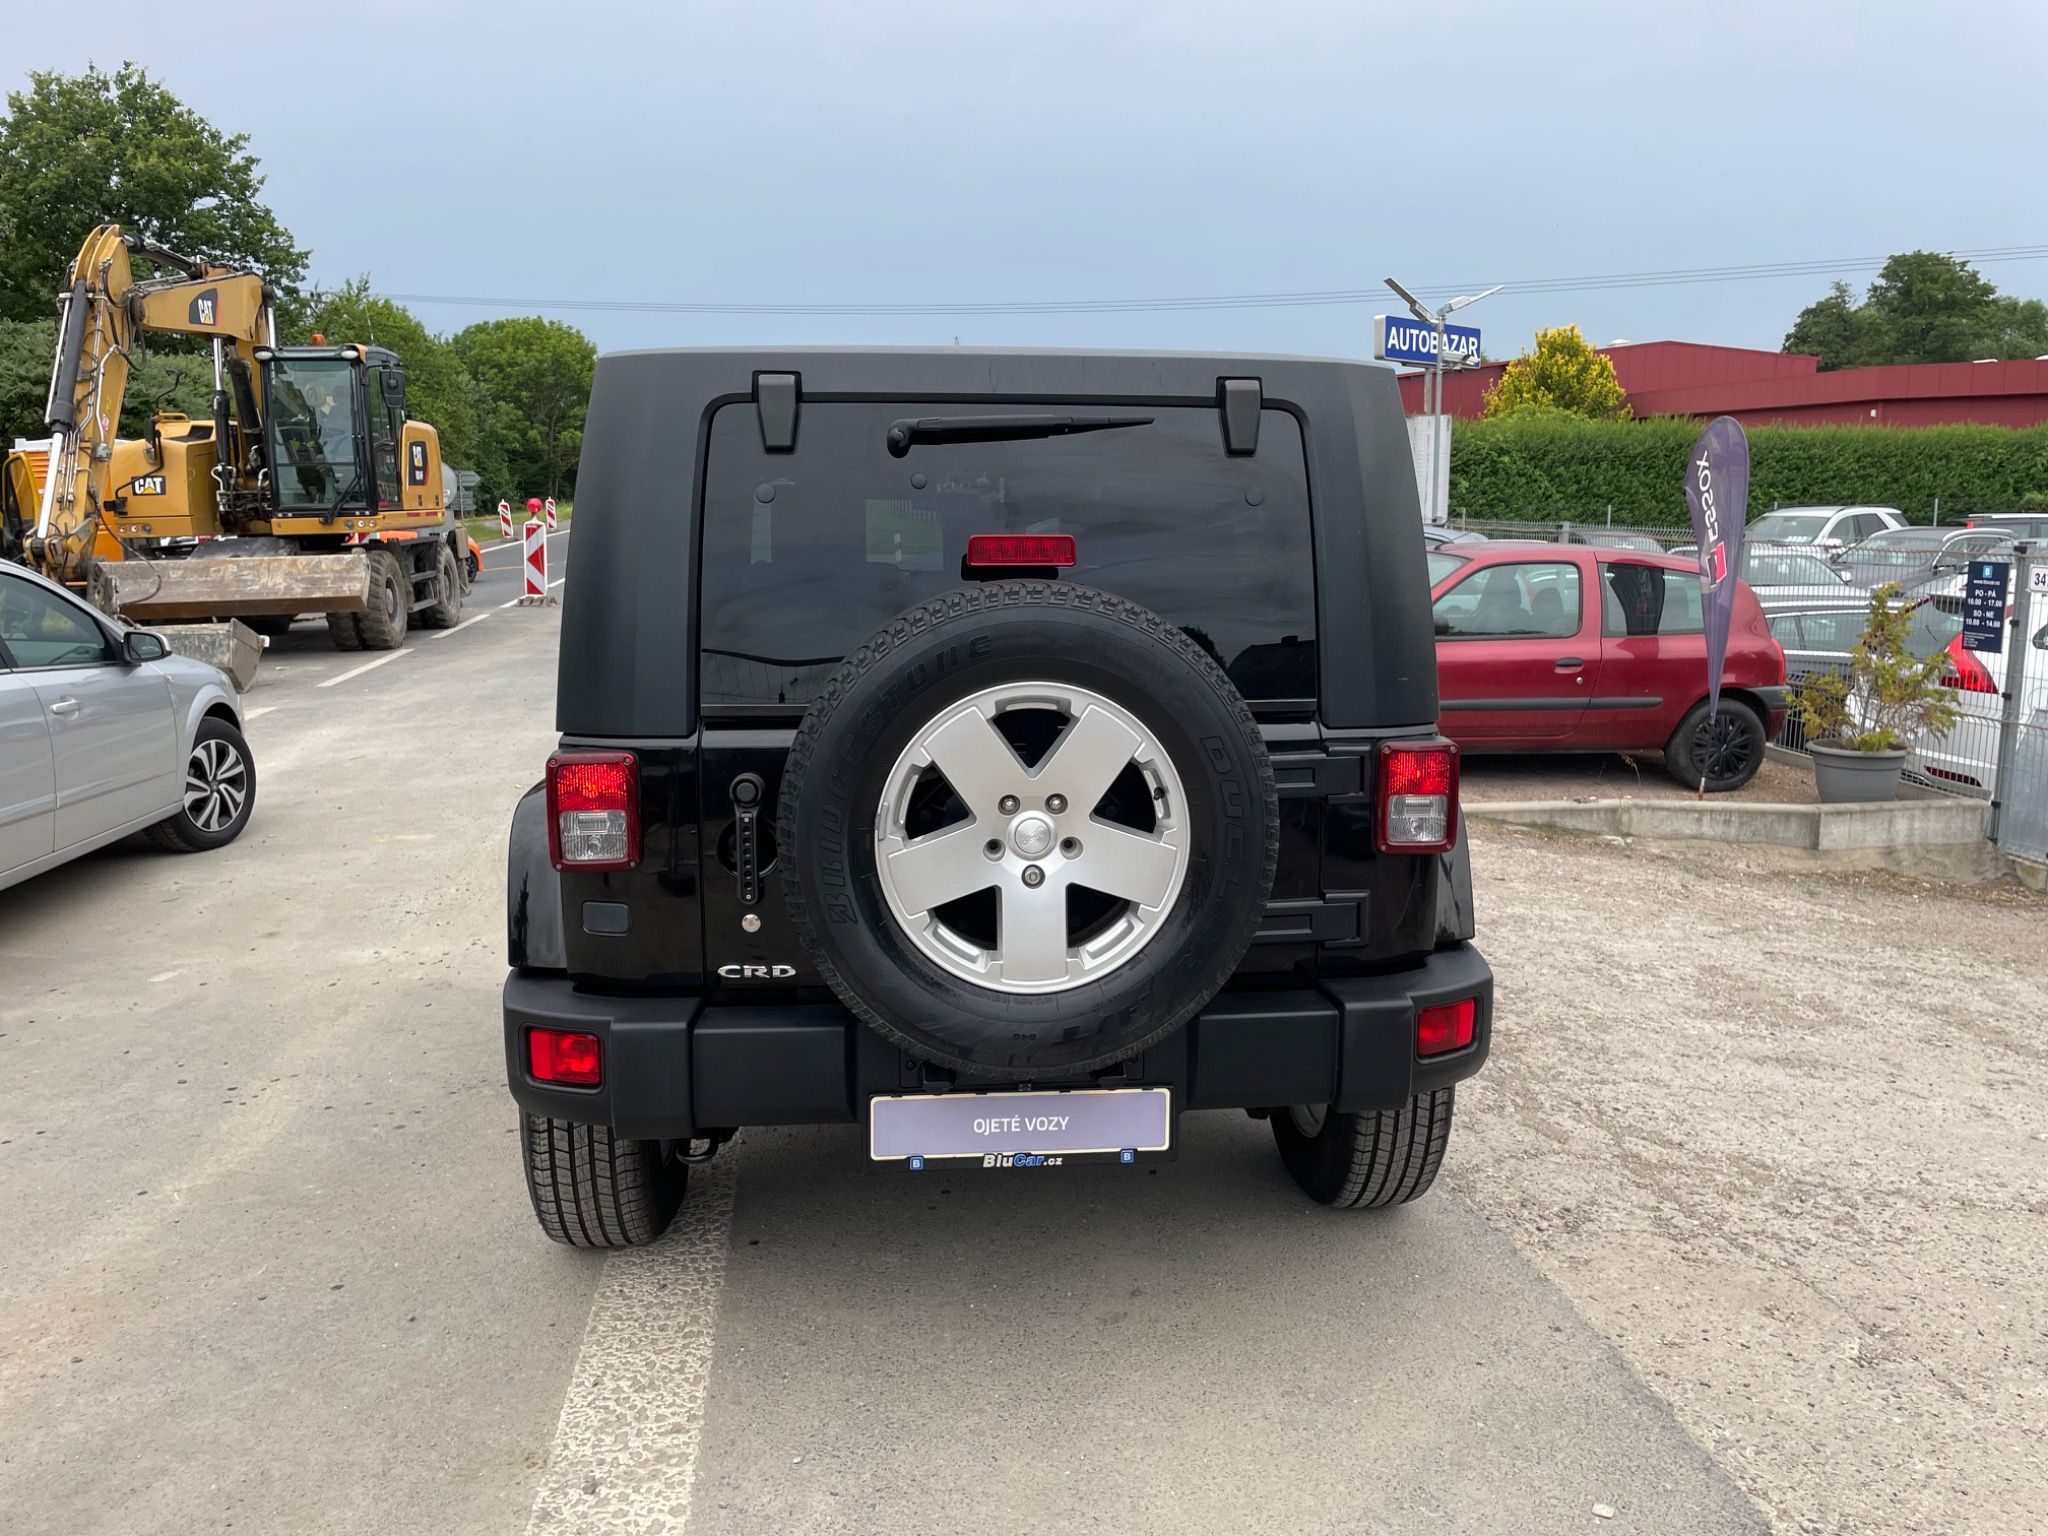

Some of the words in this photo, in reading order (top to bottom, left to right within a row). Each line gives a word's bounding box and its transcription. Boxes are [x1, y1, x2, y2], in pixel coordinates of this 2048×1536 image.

[197, 298, 214, 324] CAT
[1387, 326, 1479, 360] AUTOBAZAR
[134, 477, 162, 495] CAT
[2034, 572, 2048, 586] 34
[717, 965, 797, 978] CRD
[973, 1114, 1020, 1136] OJETÉ
[1025, 1116, 1069, 1132] VOZY
[983, 1153, 1063, 1168] BluCar.cz
